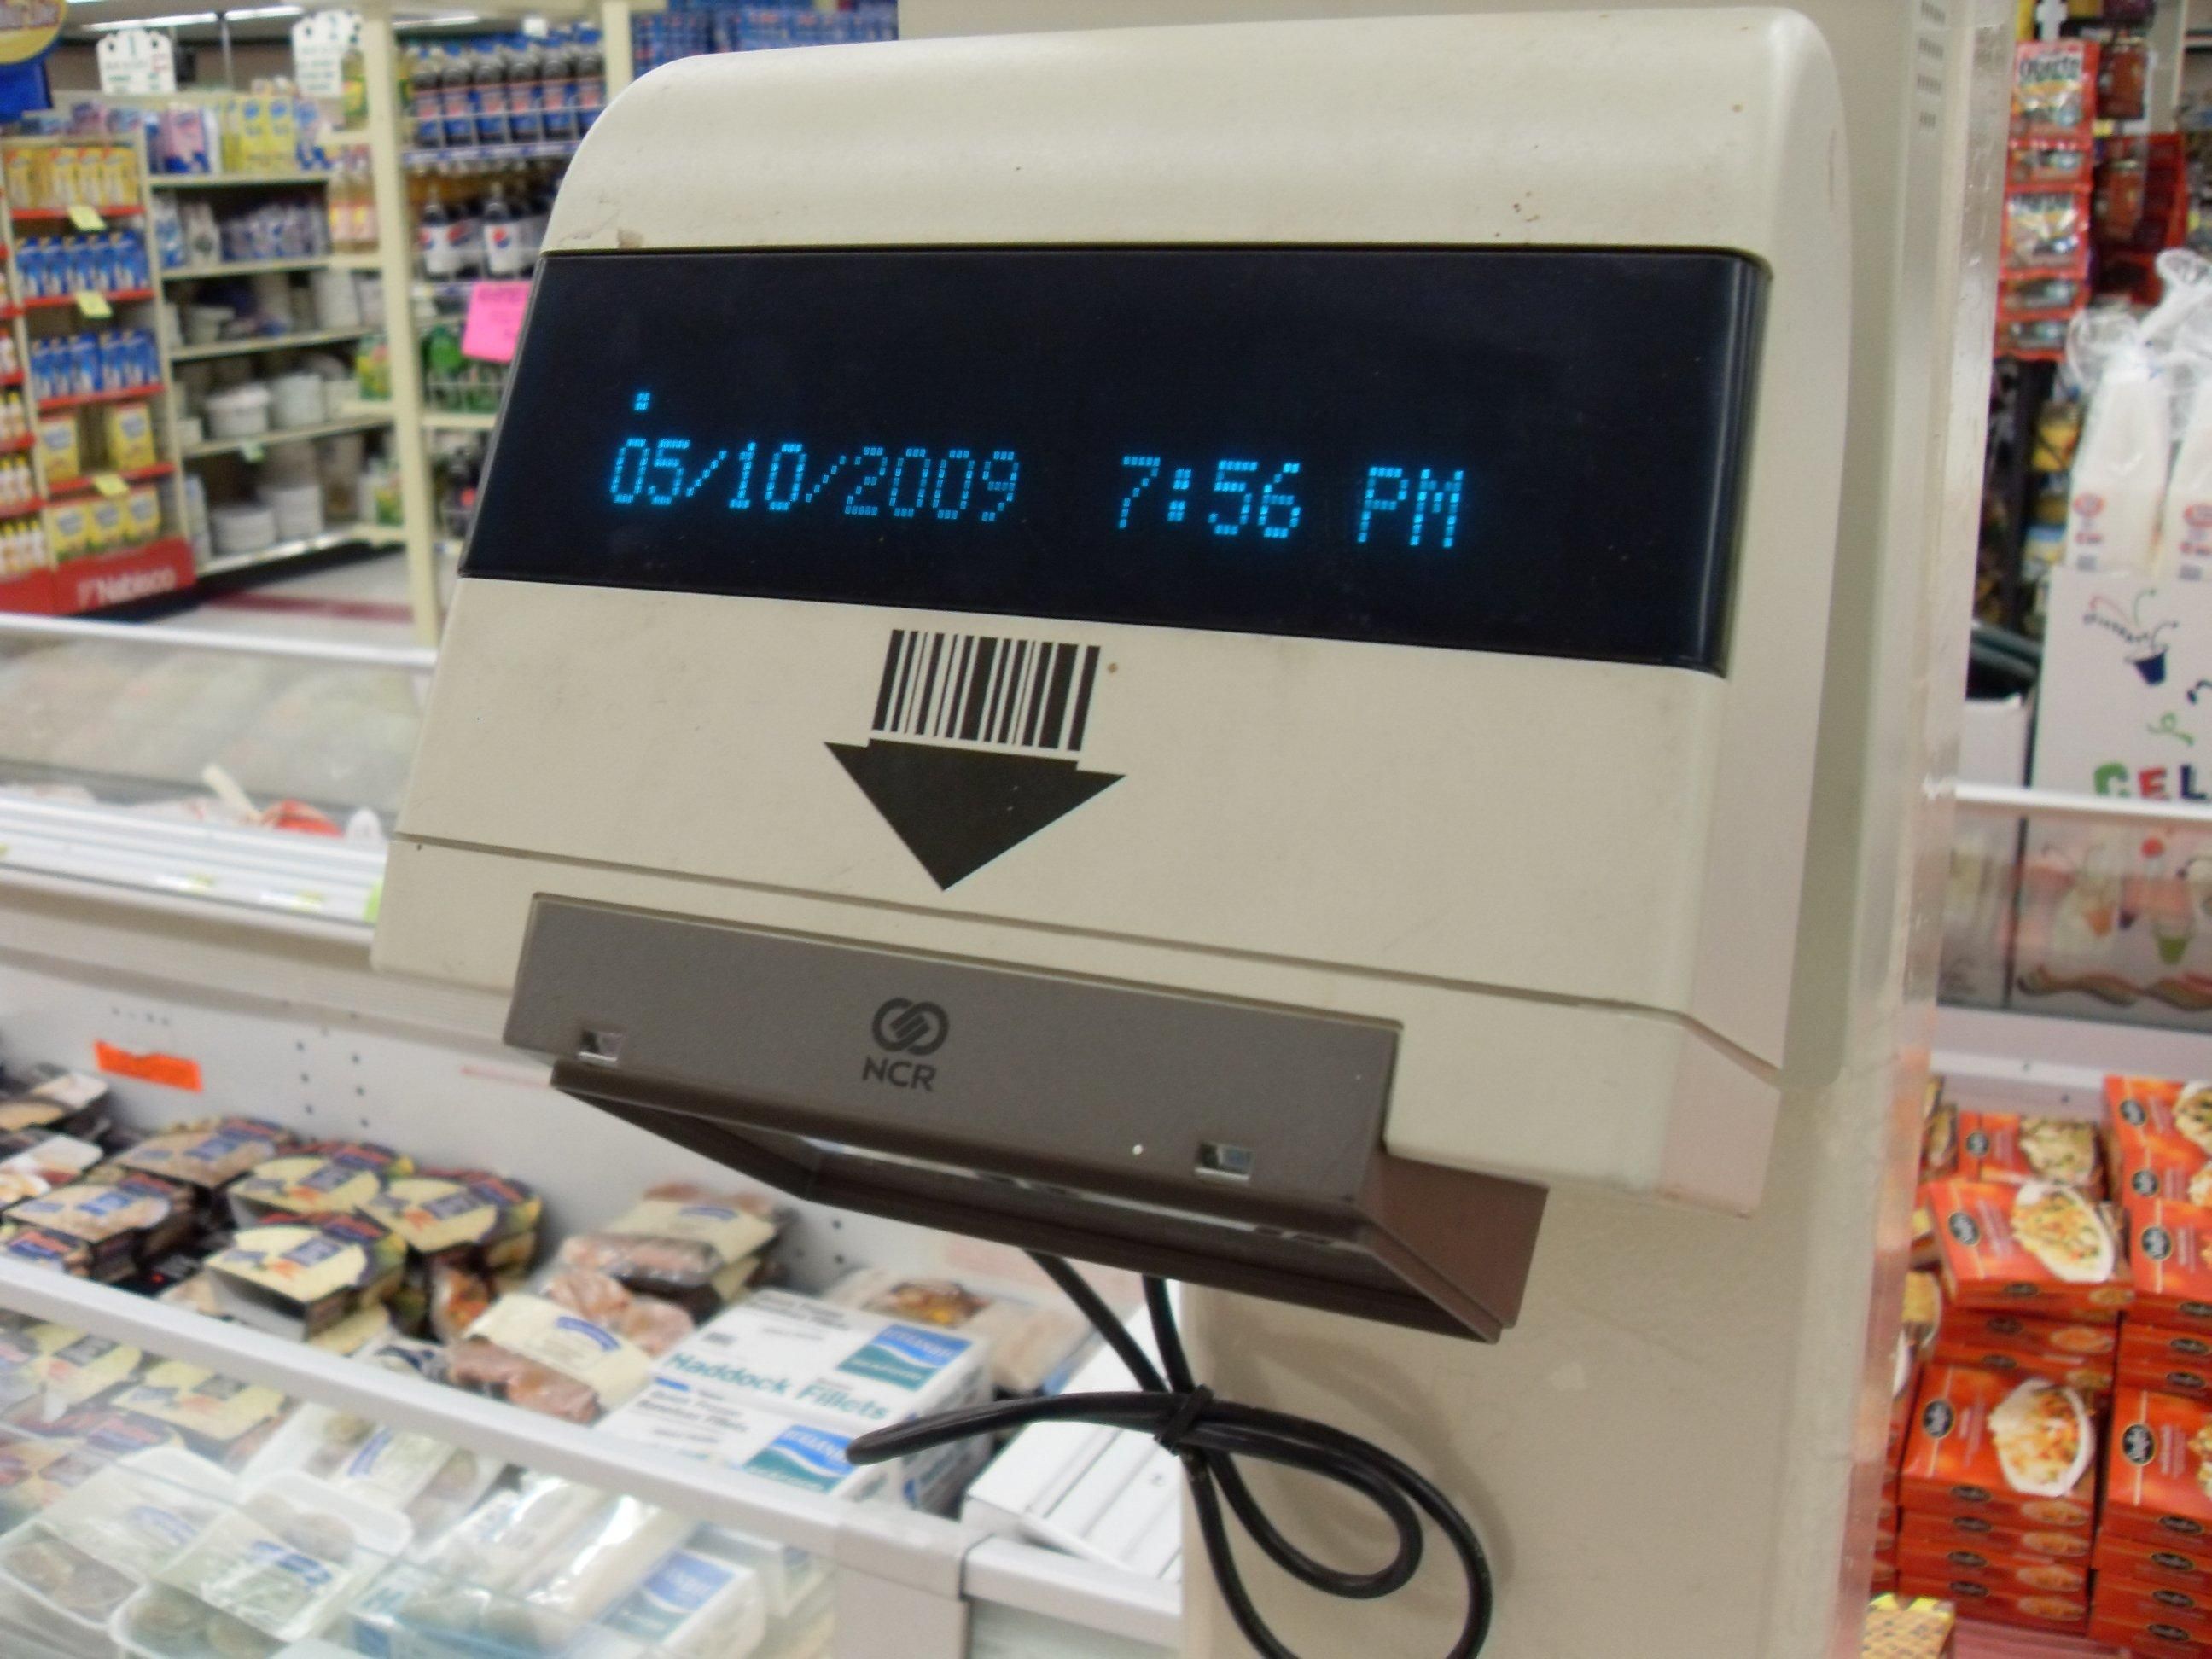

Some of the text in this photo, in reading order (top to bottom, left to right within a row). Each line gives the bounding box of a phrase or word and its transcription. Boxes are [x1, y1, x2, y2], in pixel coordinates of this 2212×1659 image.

[608, 436, 1464, 549] 05/10/2009 7:56 PM
[861, 1055, 938, 1092] NCR
[661, 1351, 793, 1397] Haddock
[795, 1381, 889, 1422] Fillets
